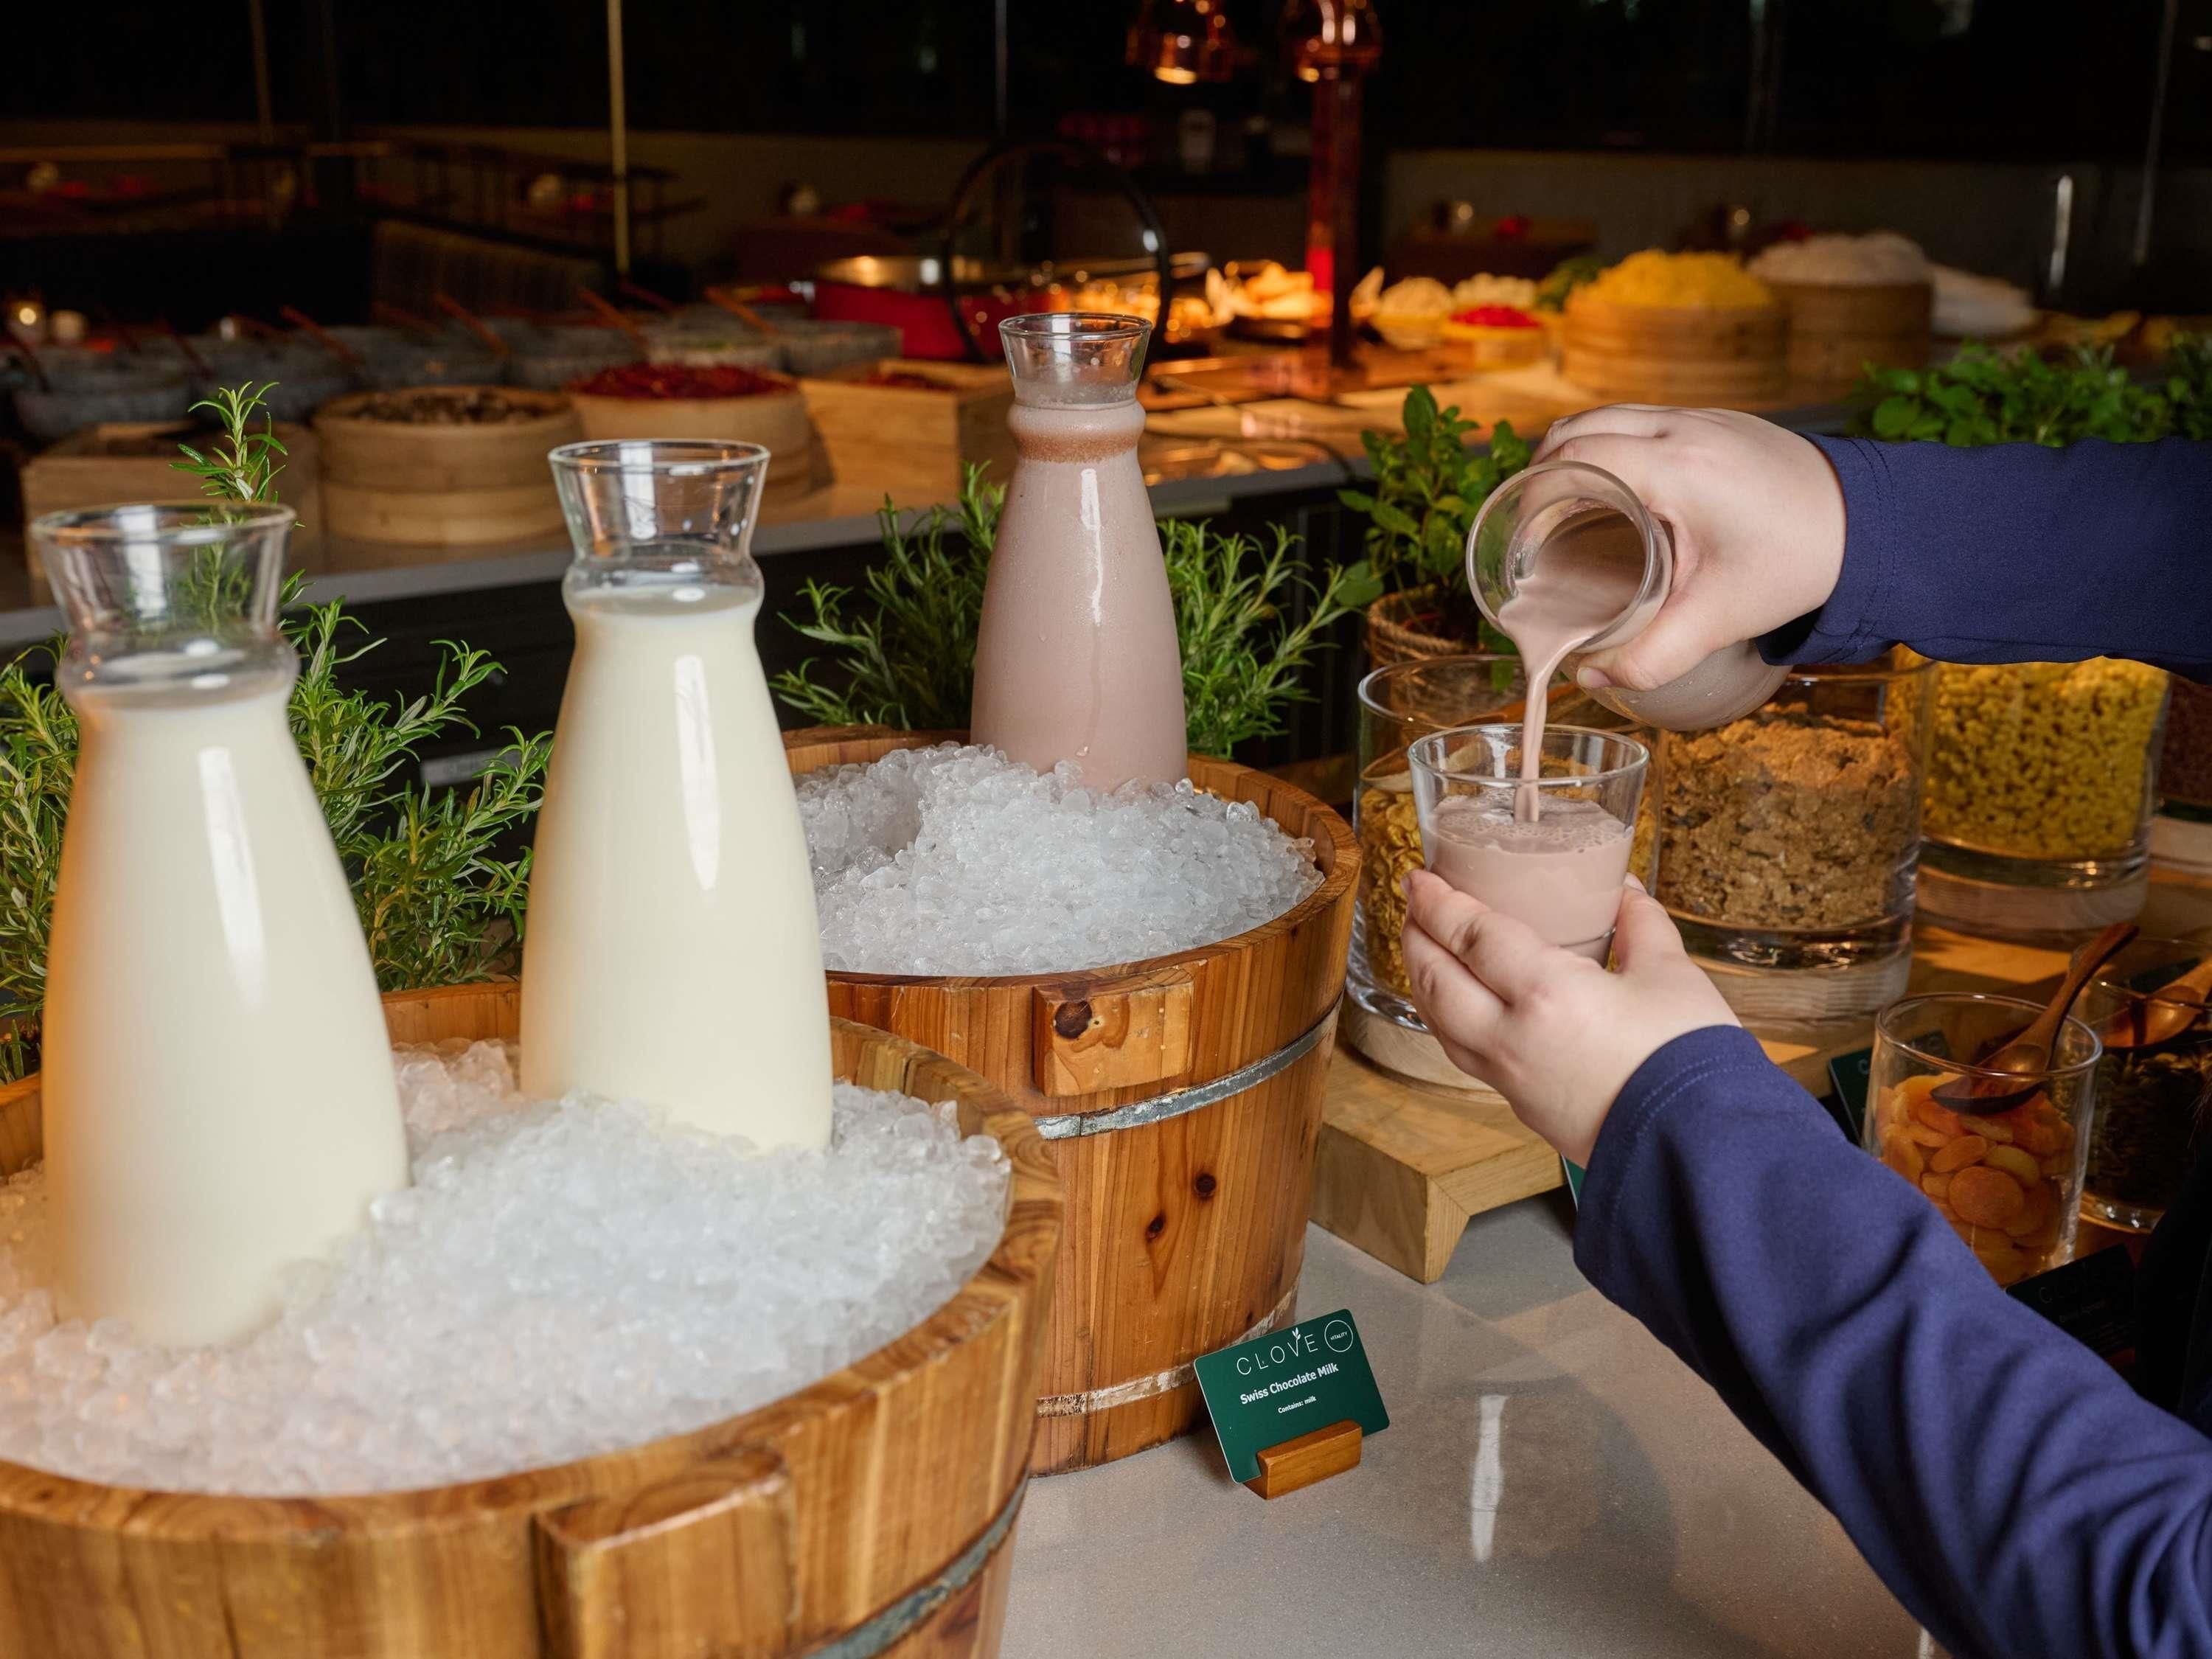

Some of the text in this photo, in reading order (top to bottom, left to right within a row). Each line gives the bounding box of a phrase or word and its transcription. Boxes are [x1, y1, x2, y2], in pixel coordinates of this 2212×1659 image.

[1237, 1328, 1318, 1375] CLOVE
[1240, 1363, 1339, 1405] Swiss Chocolate Milk
[1278, 1396, 1317, 1413] Contains: milk
